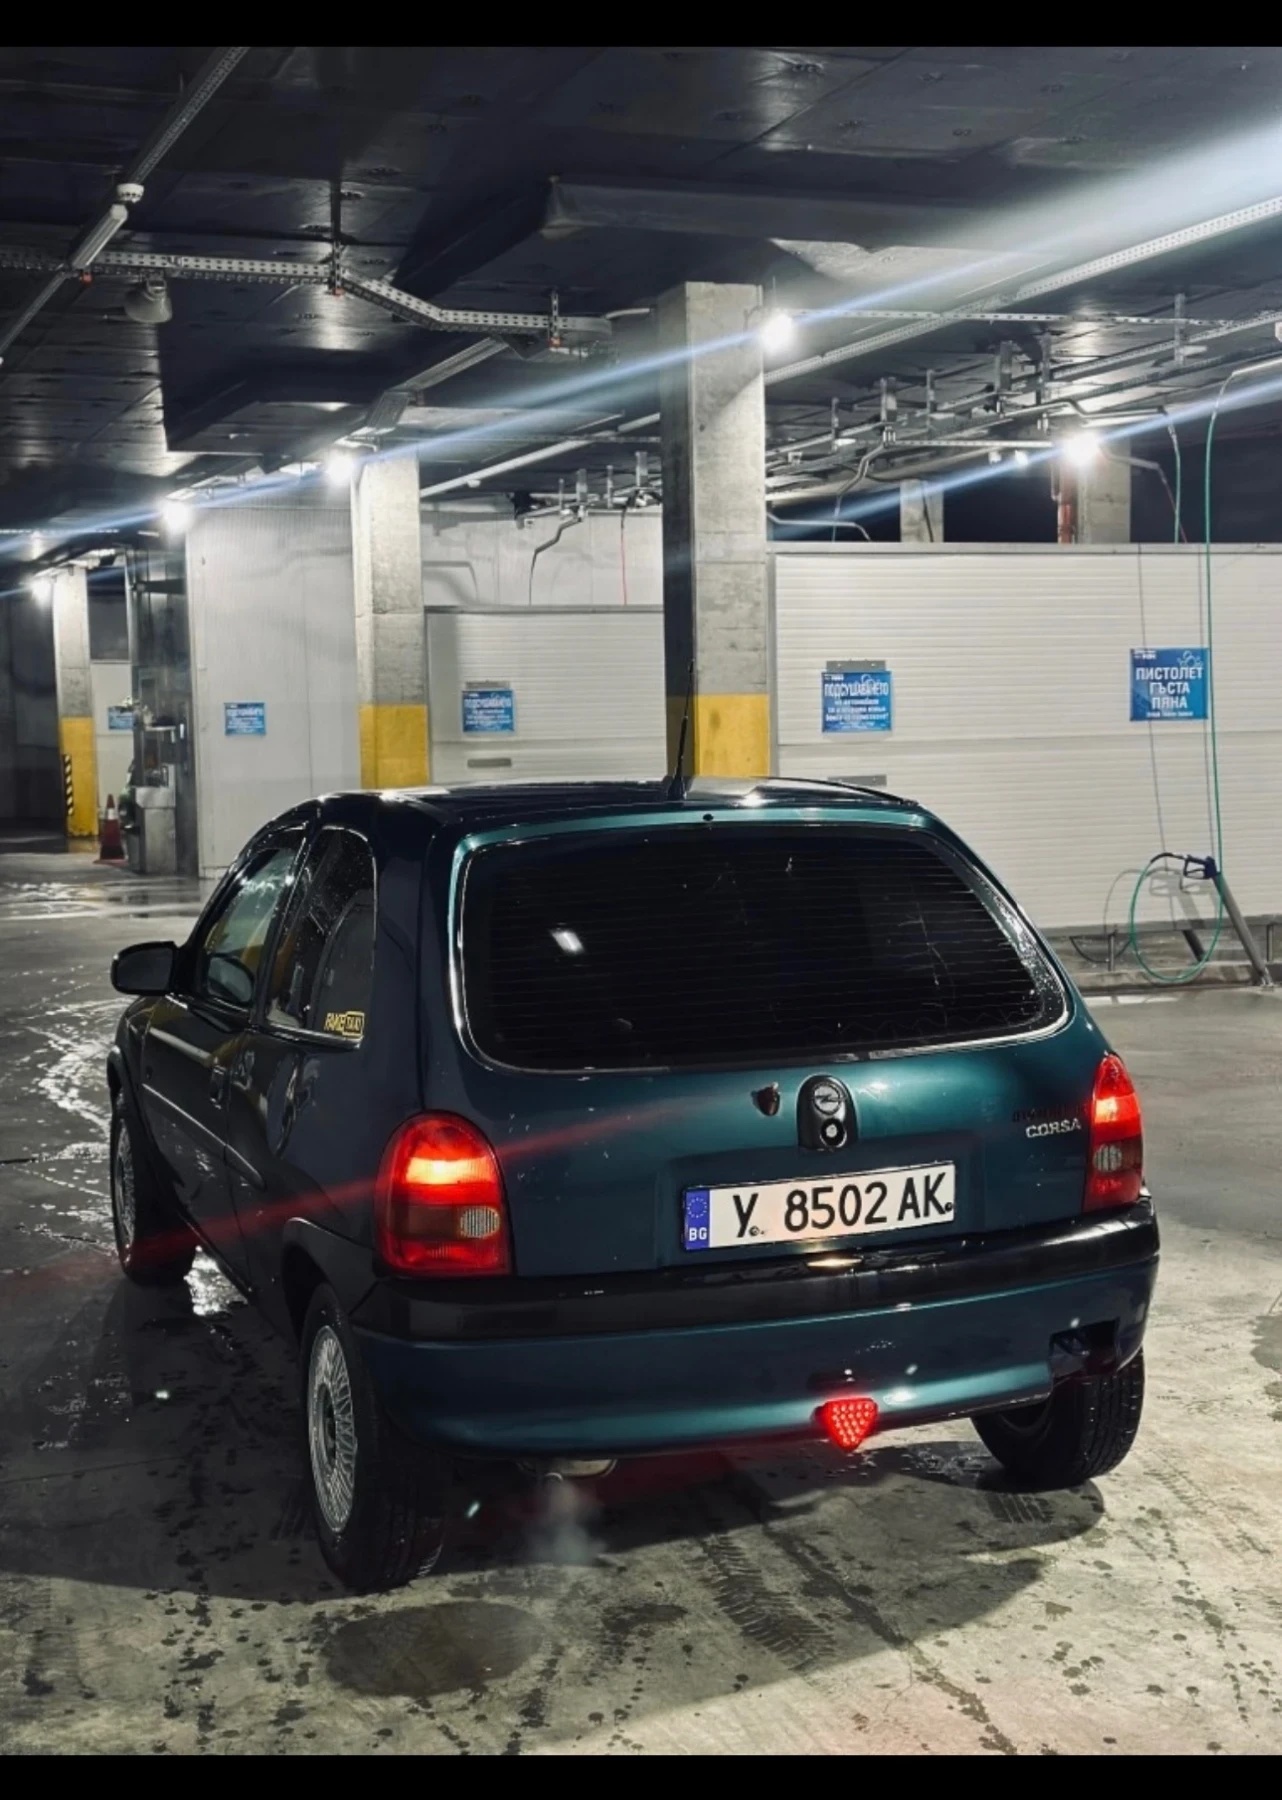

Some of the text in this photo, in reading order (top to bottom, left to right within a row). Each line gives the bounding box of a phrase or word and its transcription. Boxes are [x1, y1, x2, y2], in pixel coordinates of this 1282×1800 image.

[1135, 667, 1204, 680] ПИСТОЛЕТ
[1149, 681, 1190, 695] ГЪСТА
[1151, 695, 1188, 710] ПЯНА
[1025, 1117, 1081, 1138] CORSA
[784, 1181, 888, 1233] 8502
[688, 1227, 708, 1241] BG
